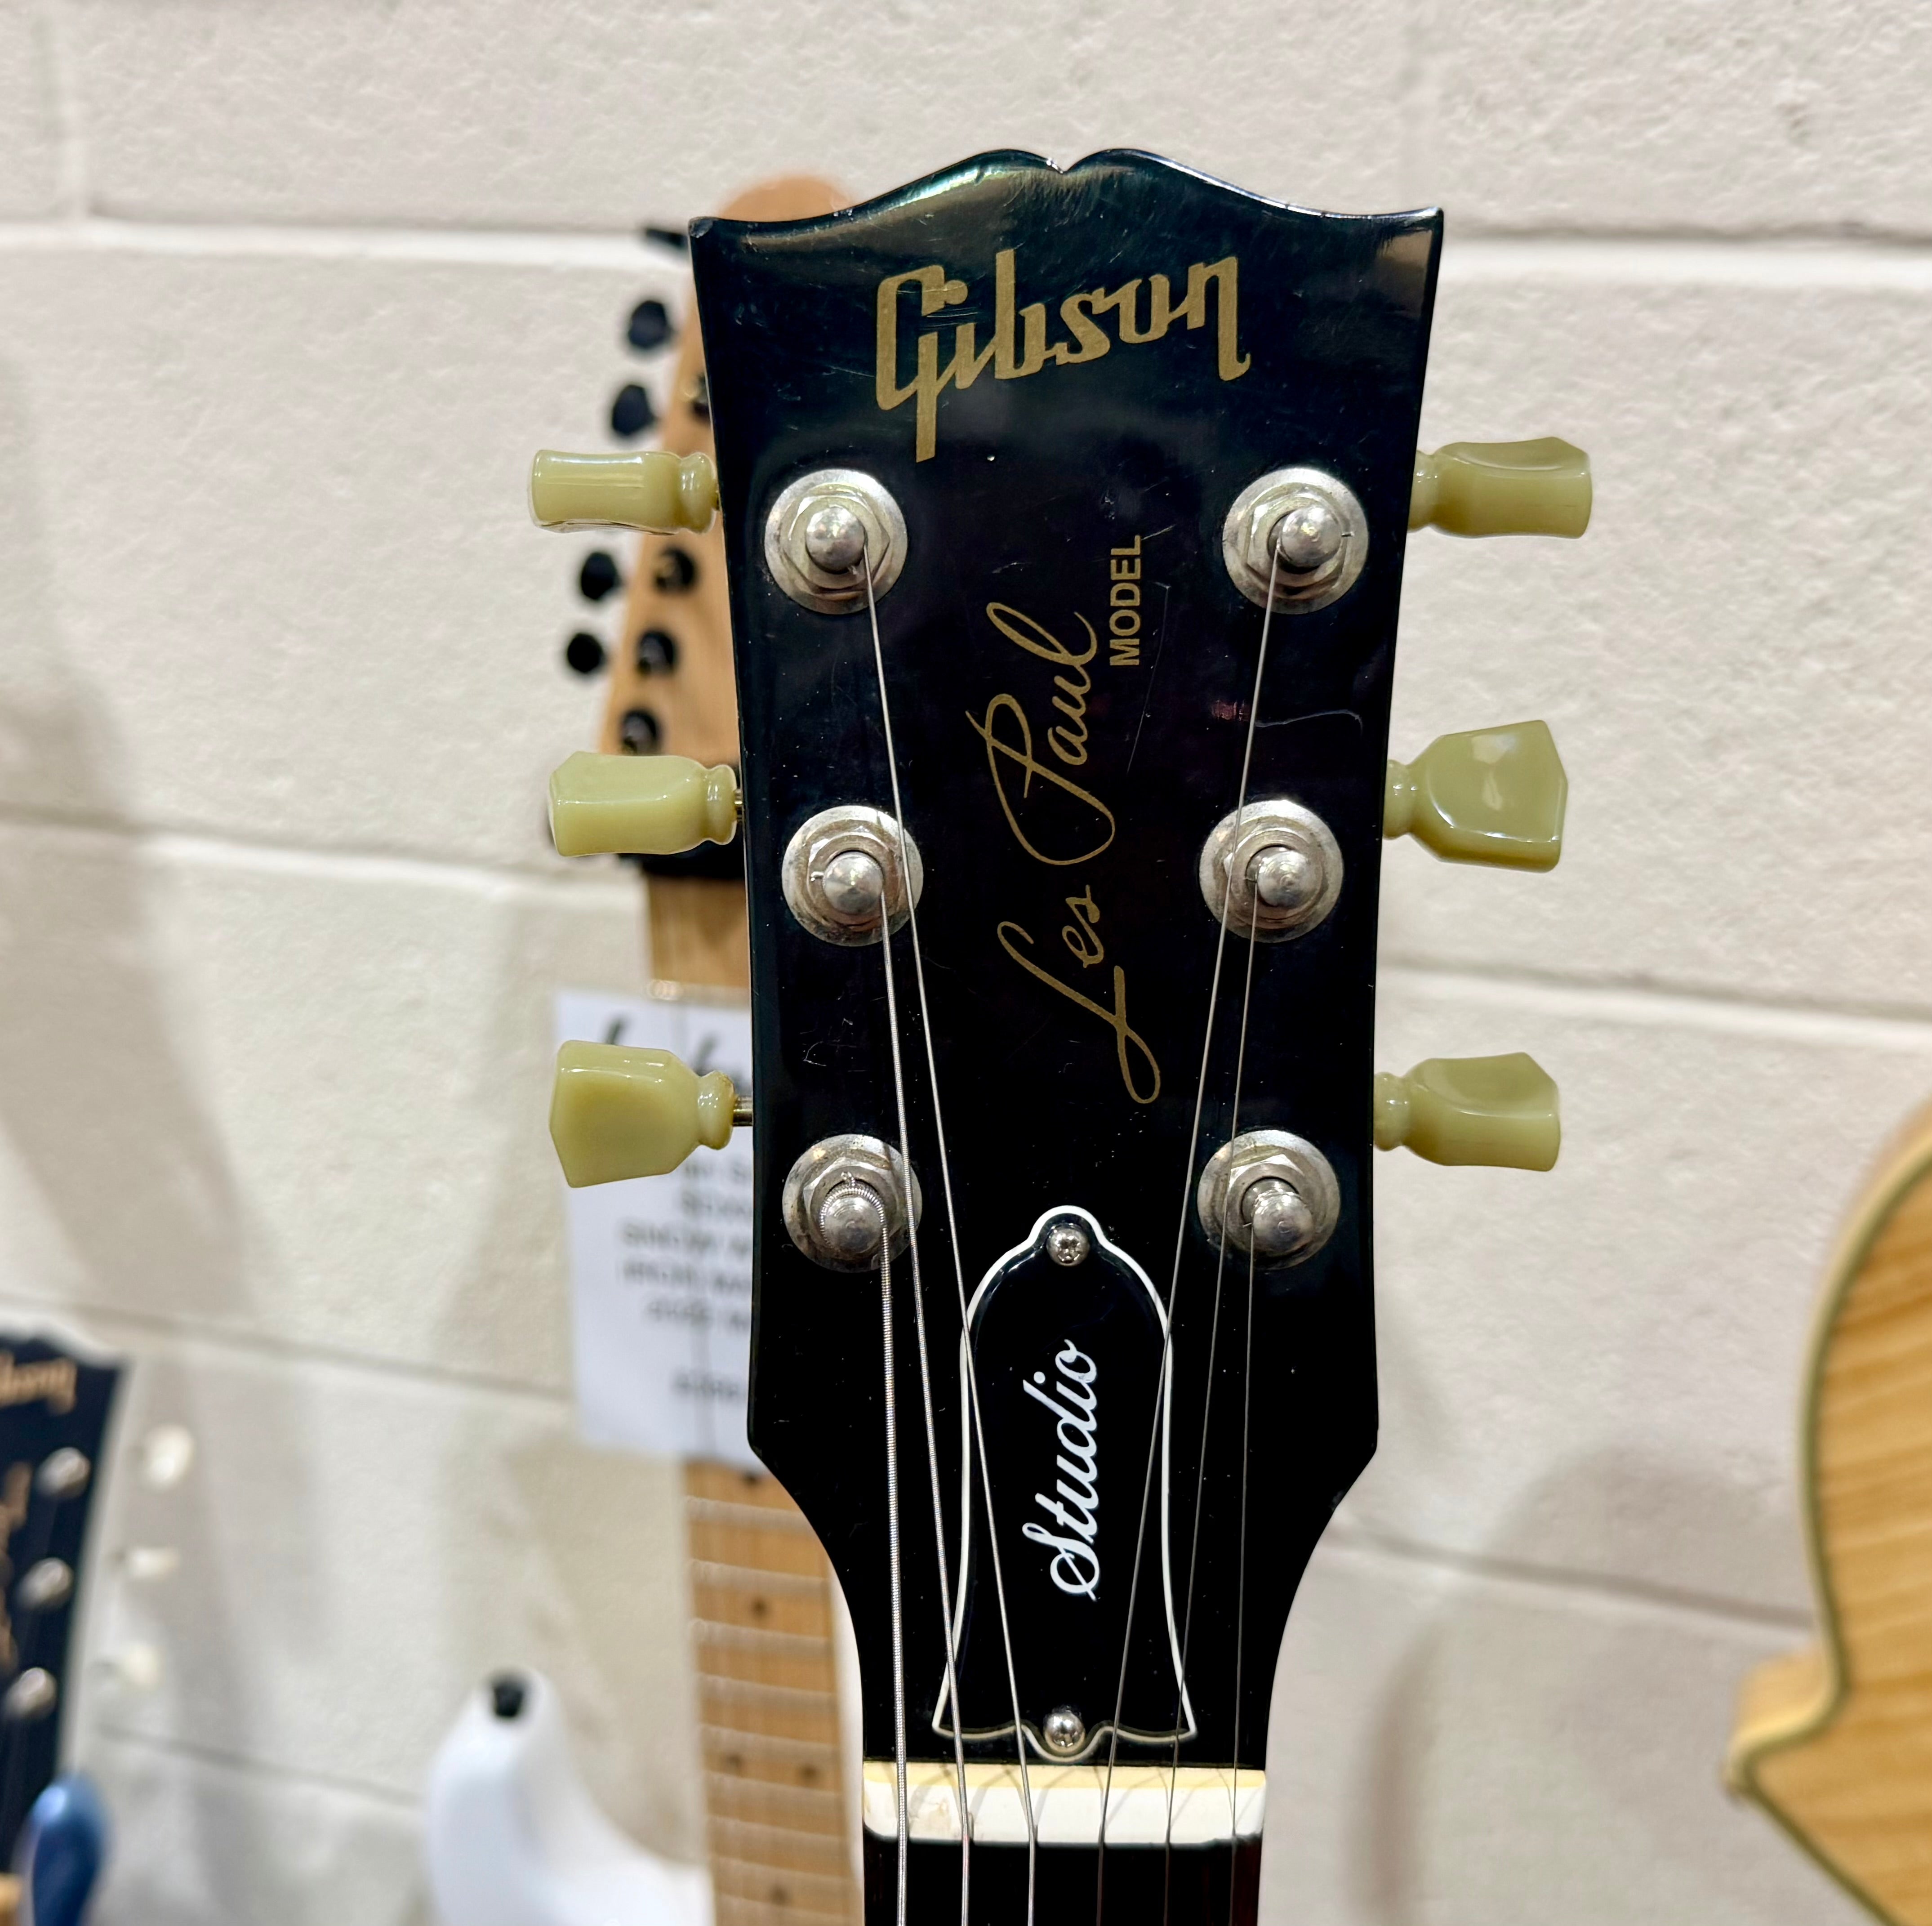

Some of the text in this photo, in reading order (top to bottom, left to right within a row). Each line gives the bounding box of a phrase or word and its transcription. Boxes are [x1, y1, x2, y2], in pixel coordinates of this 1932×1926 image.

[876, 249, 1251, 463] Gibson
[1110, 535, 1141, 666] MODEL
[966, 603, 1161, 1104] Les Paul
[1022, 1338, 1100, 1601] Studio
